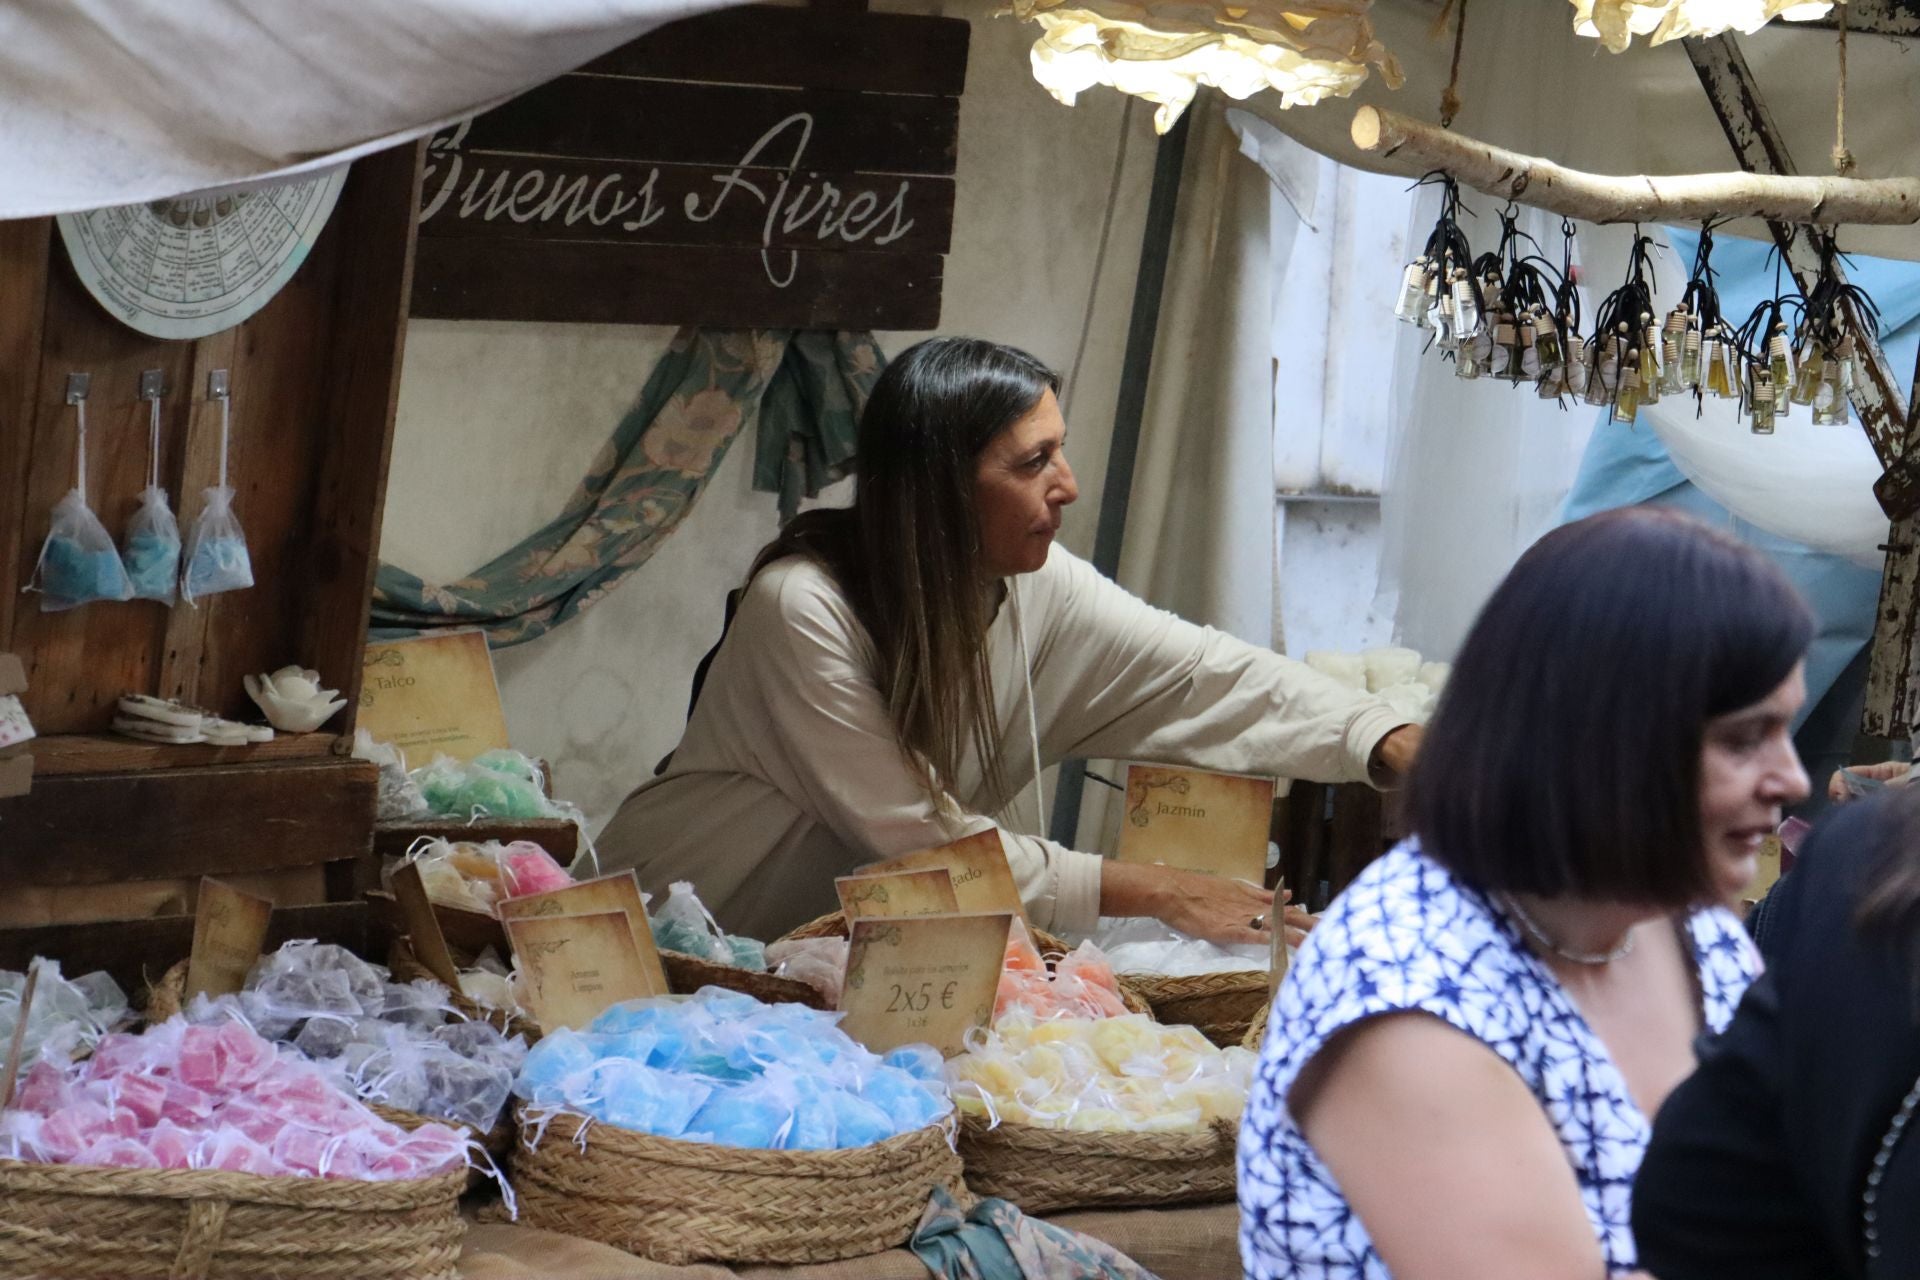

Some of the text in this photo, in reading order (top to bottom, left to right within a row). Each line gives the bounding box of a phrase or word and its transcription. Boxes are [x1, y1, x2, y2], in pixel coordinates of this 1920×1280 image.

[684, 112, 915, 288] Aires
[375, 674, 416, 691] Talco
[885, 980, 958, 1014] 2x5 €
